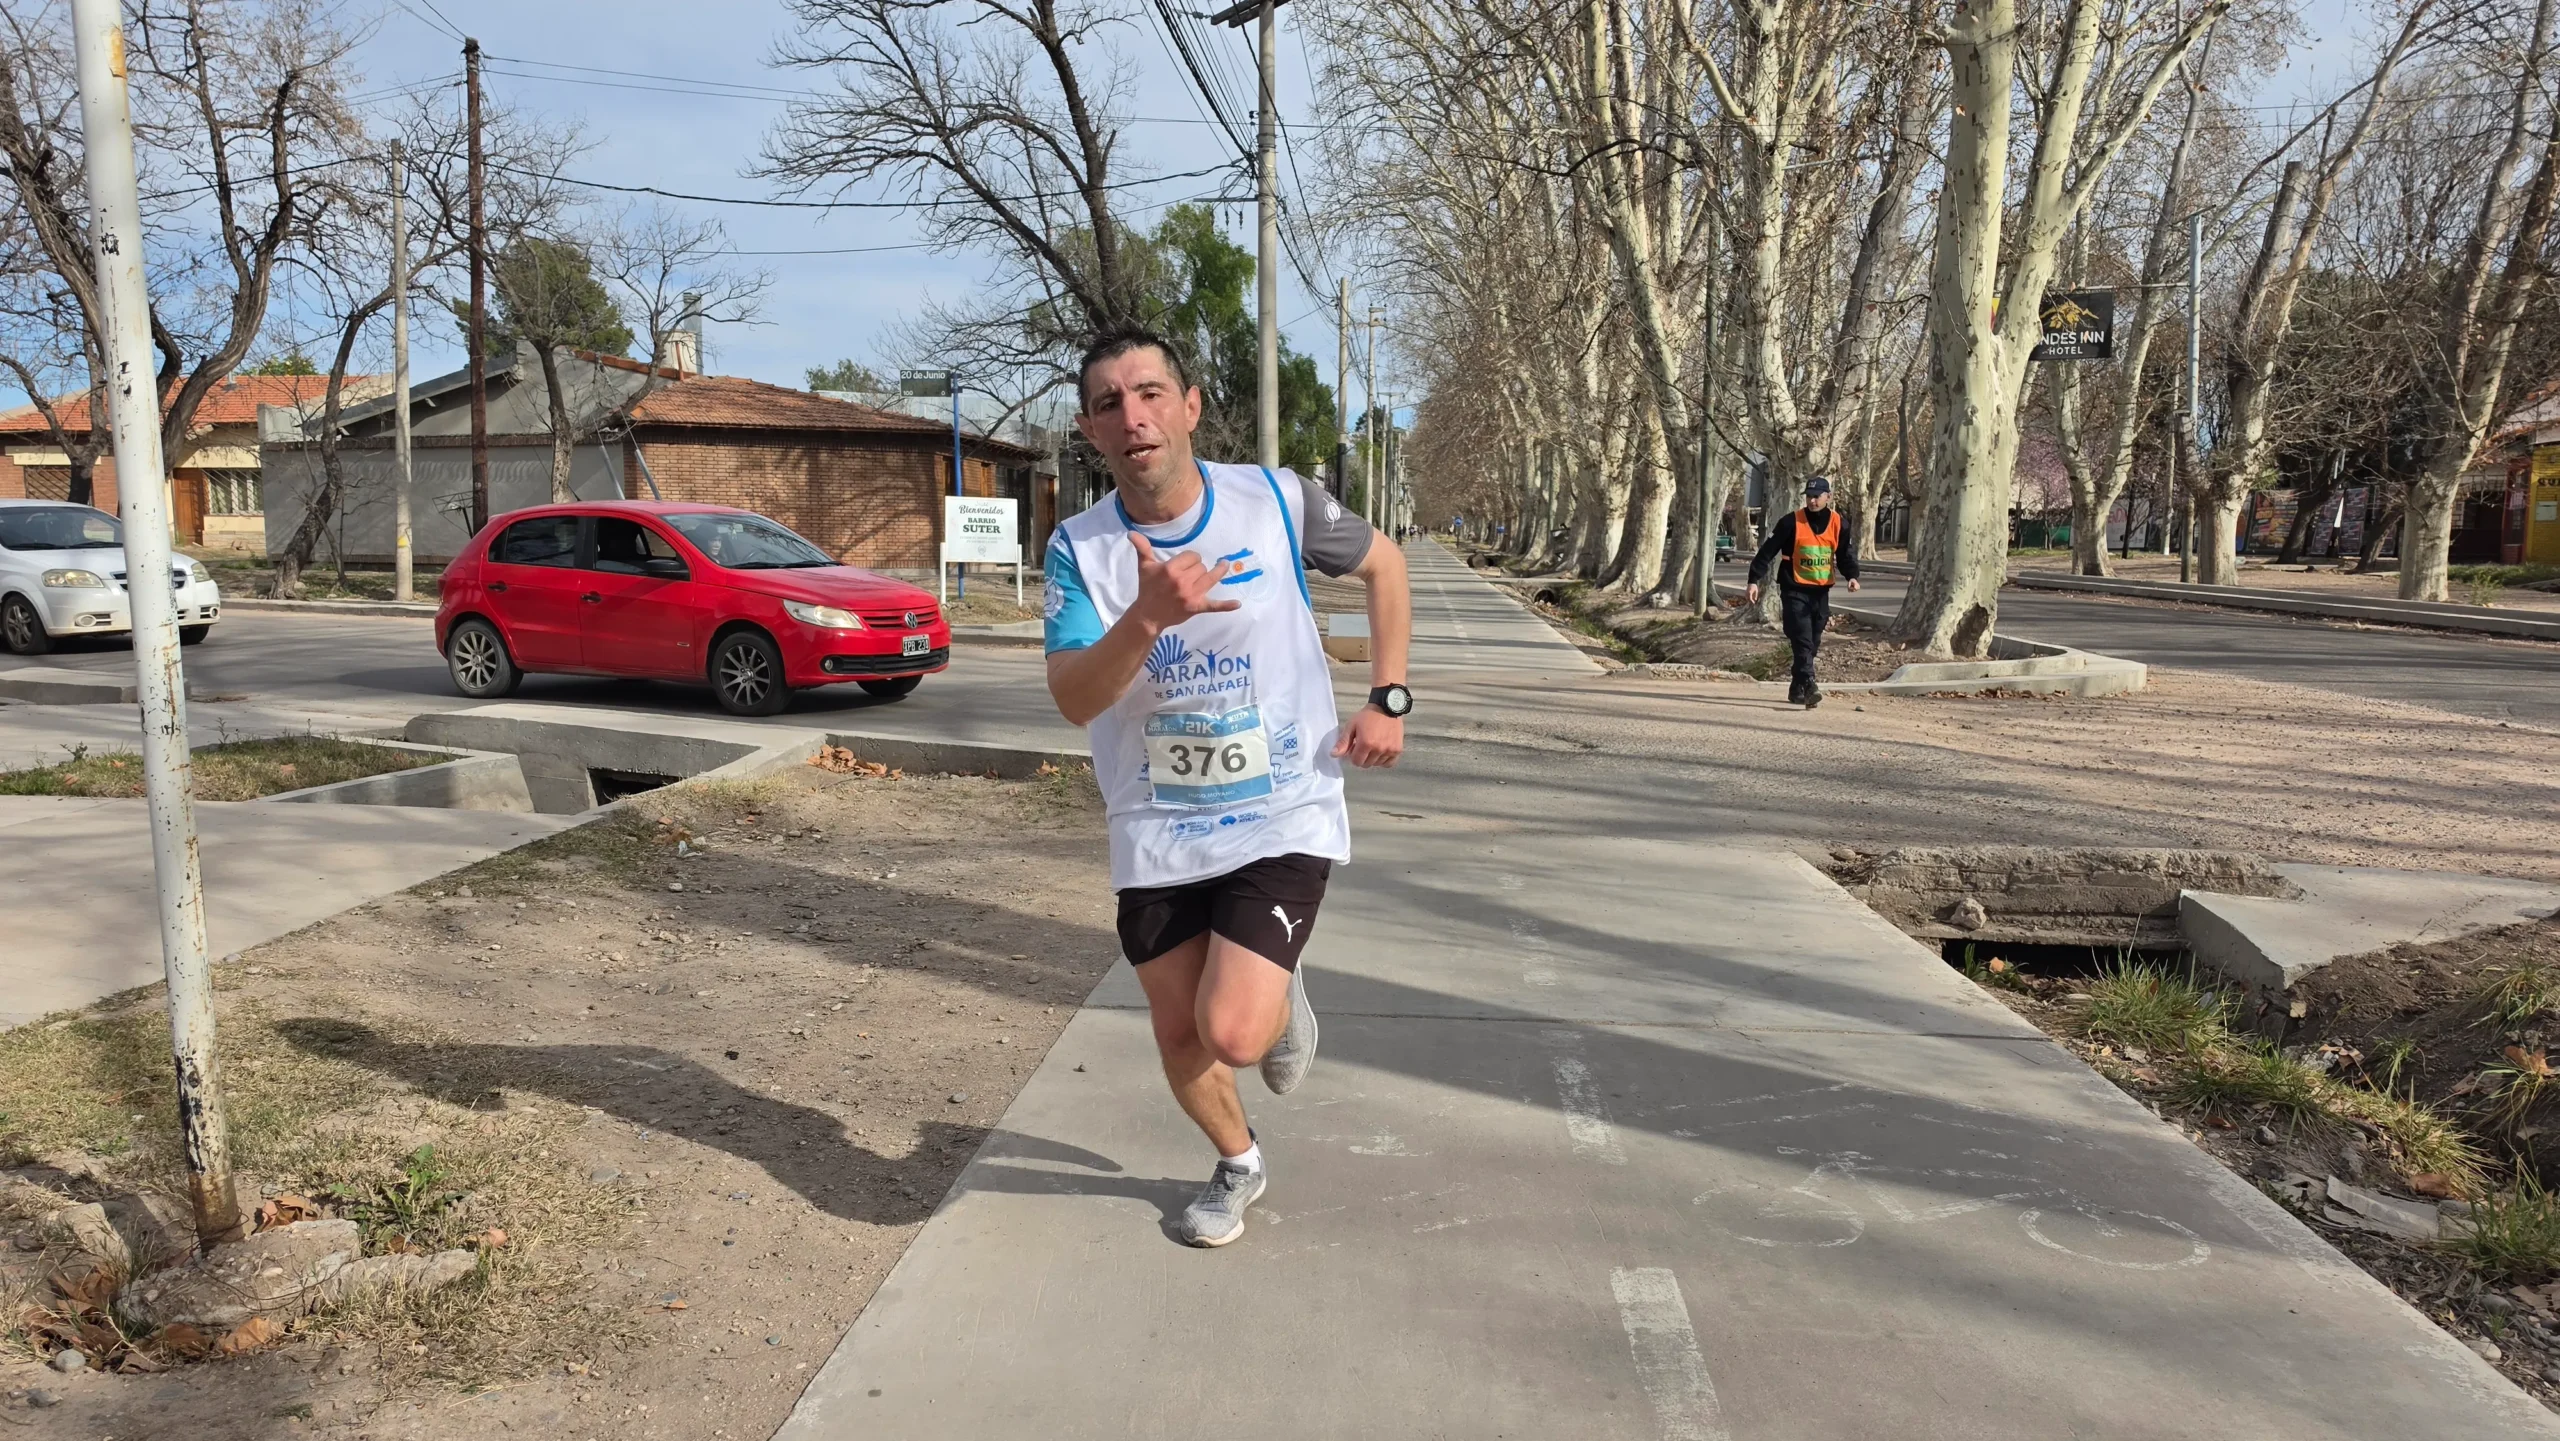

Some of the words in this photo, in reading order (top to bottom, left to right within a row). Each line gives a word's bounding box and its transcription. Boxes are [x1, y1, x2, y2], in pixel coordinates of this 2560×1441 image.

[2039, 332, 2077, 345] NDES
[2080, 330, 2105, 344] INN
[2048, 346, 2083, 355] HOTEL
[901, 371, 911, 379] 20
[913, 371, 922, 379] de
[923, 371, 946, 379] Junio
[959, 504, 1004, 515] Bienvenidos
[963, 524, 1001, 534] SUTER
[1155, 691, 1163, 699] DE
[1166, 685, 1194, 699] SAN
[1197, 676, 1251, 695] RAFAEL
[1185, 720, 1215, 734] 21K
[1168, 742, 1247, 777] 376
